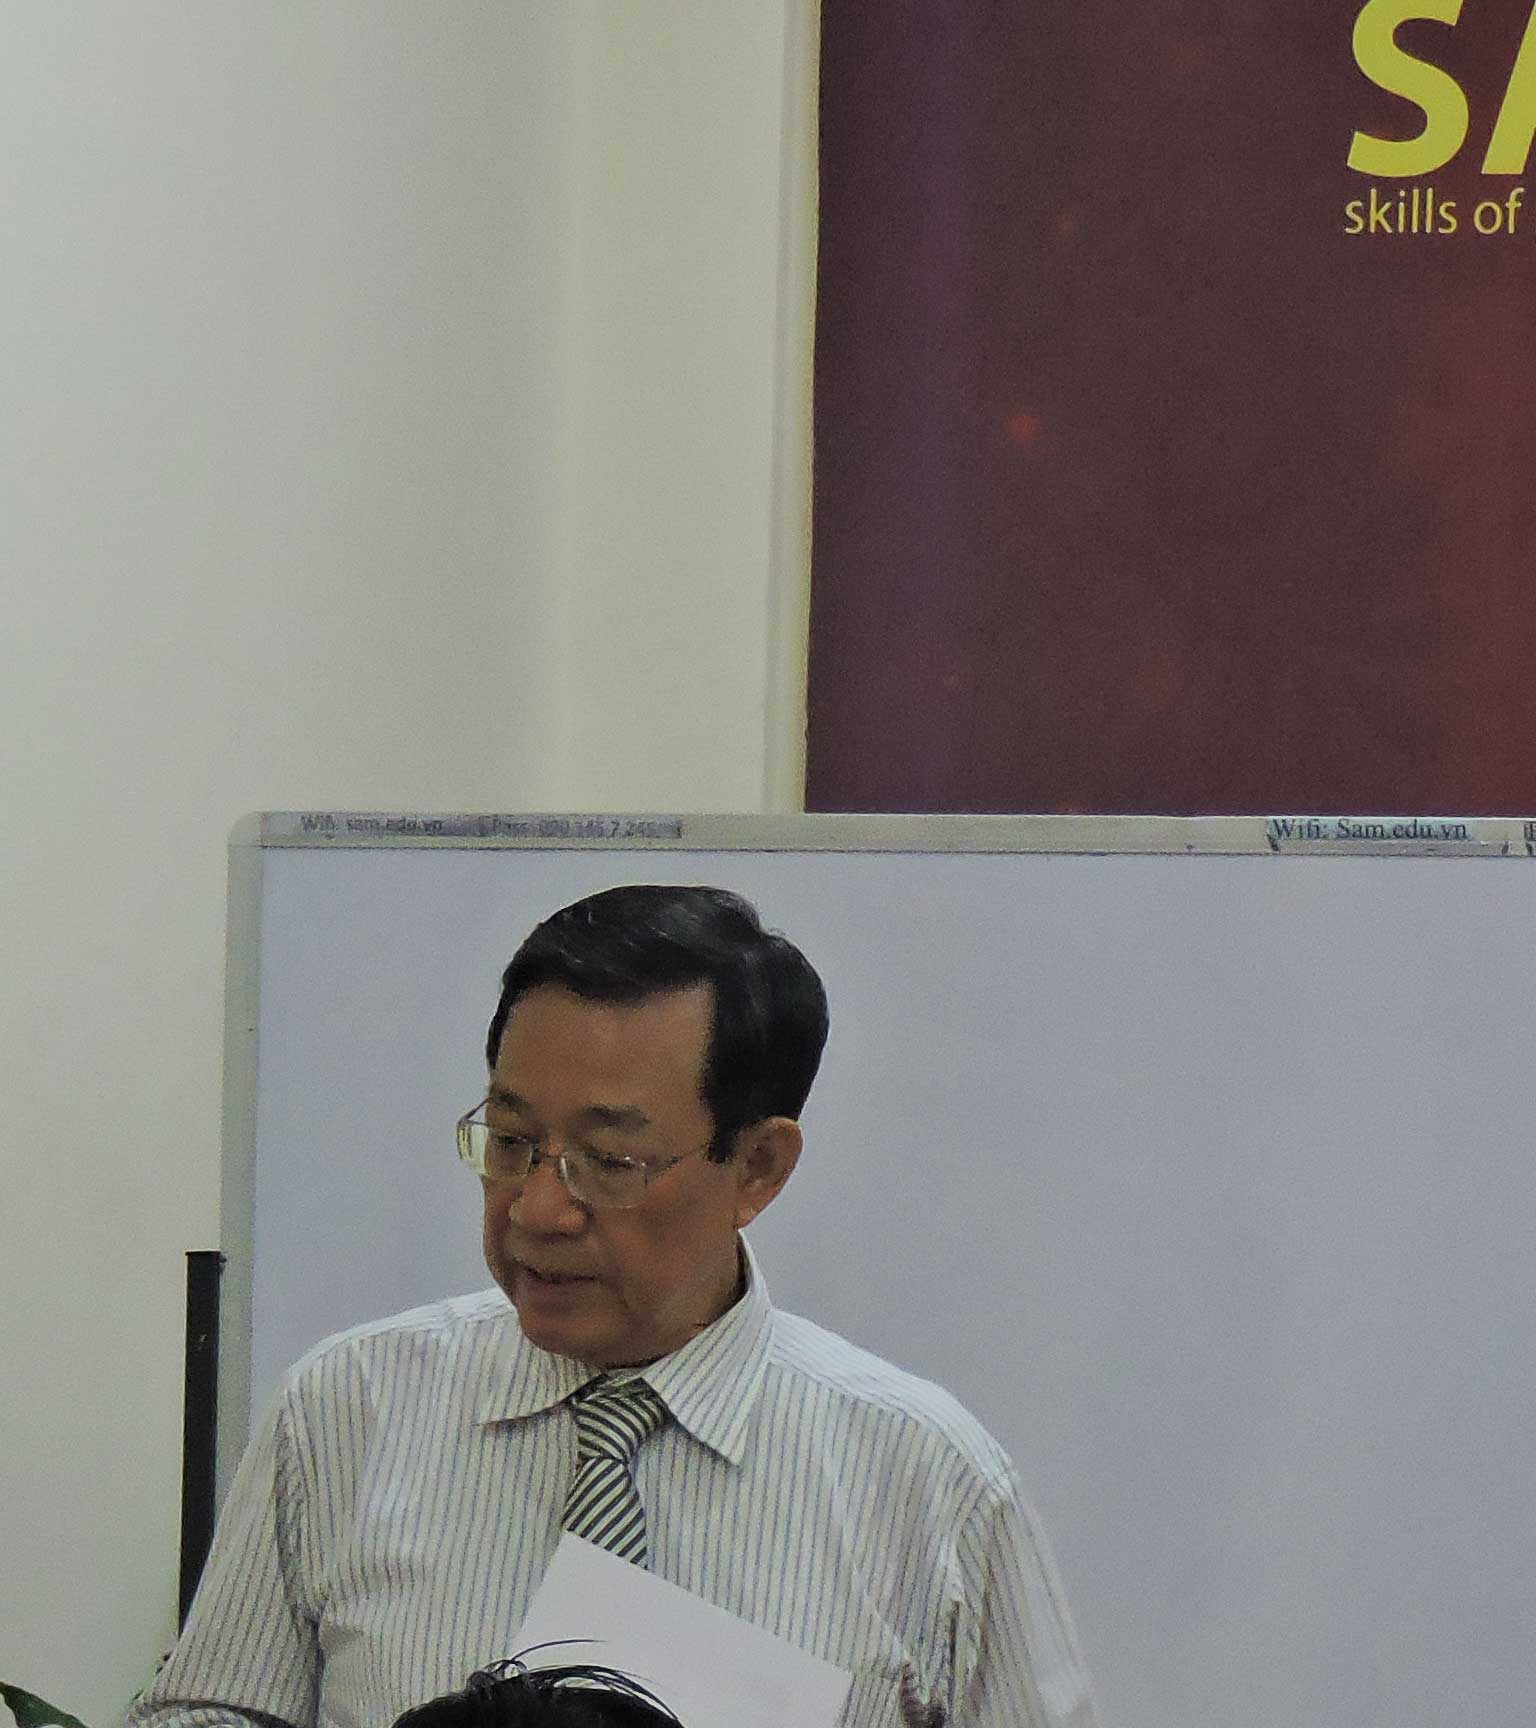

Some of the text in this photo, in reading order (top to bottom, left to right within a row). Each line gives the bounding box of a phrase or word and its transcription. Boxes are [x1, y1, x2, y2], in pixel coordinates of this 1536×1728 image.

[1345, 187, 1458, 234] skills
[1473, 187, 1524, 235] of
[1335, 818, 1469, 842] Sam.edu.vn
